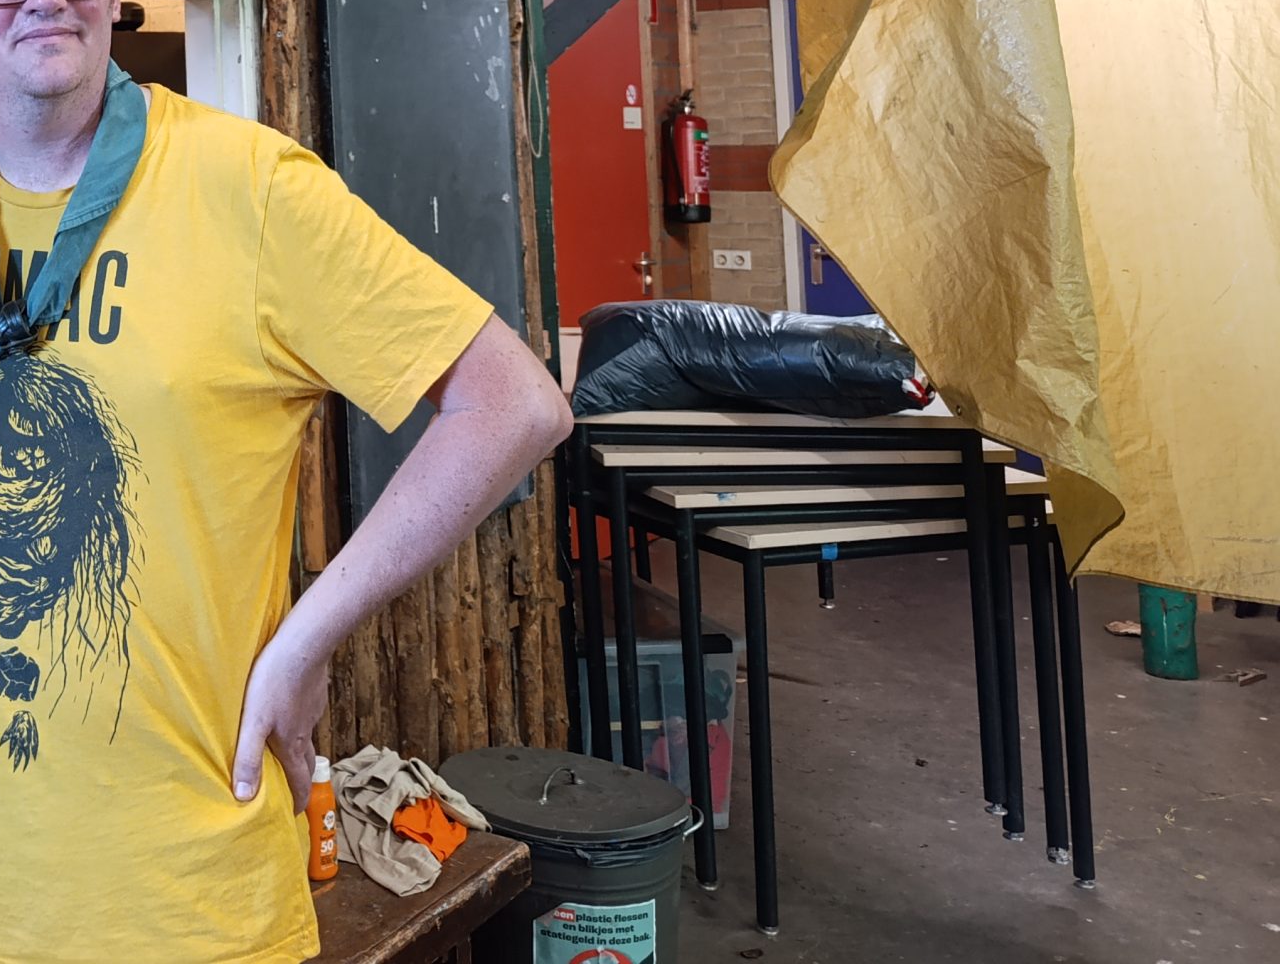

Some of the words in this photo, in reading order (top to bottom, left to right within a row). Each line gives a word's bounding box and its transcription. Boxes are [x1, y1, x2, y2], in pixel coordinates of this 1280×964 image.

[576, 913, 612, 923] plastic
[614, 912, 648, 923] flessen
[563, 923, 576, 932] en
[578, 924, 613, 936] blikjes
[615, 925, 634, 934] met
[597, 937, 606, 945] in
[609, 937, 631, 945] deze
